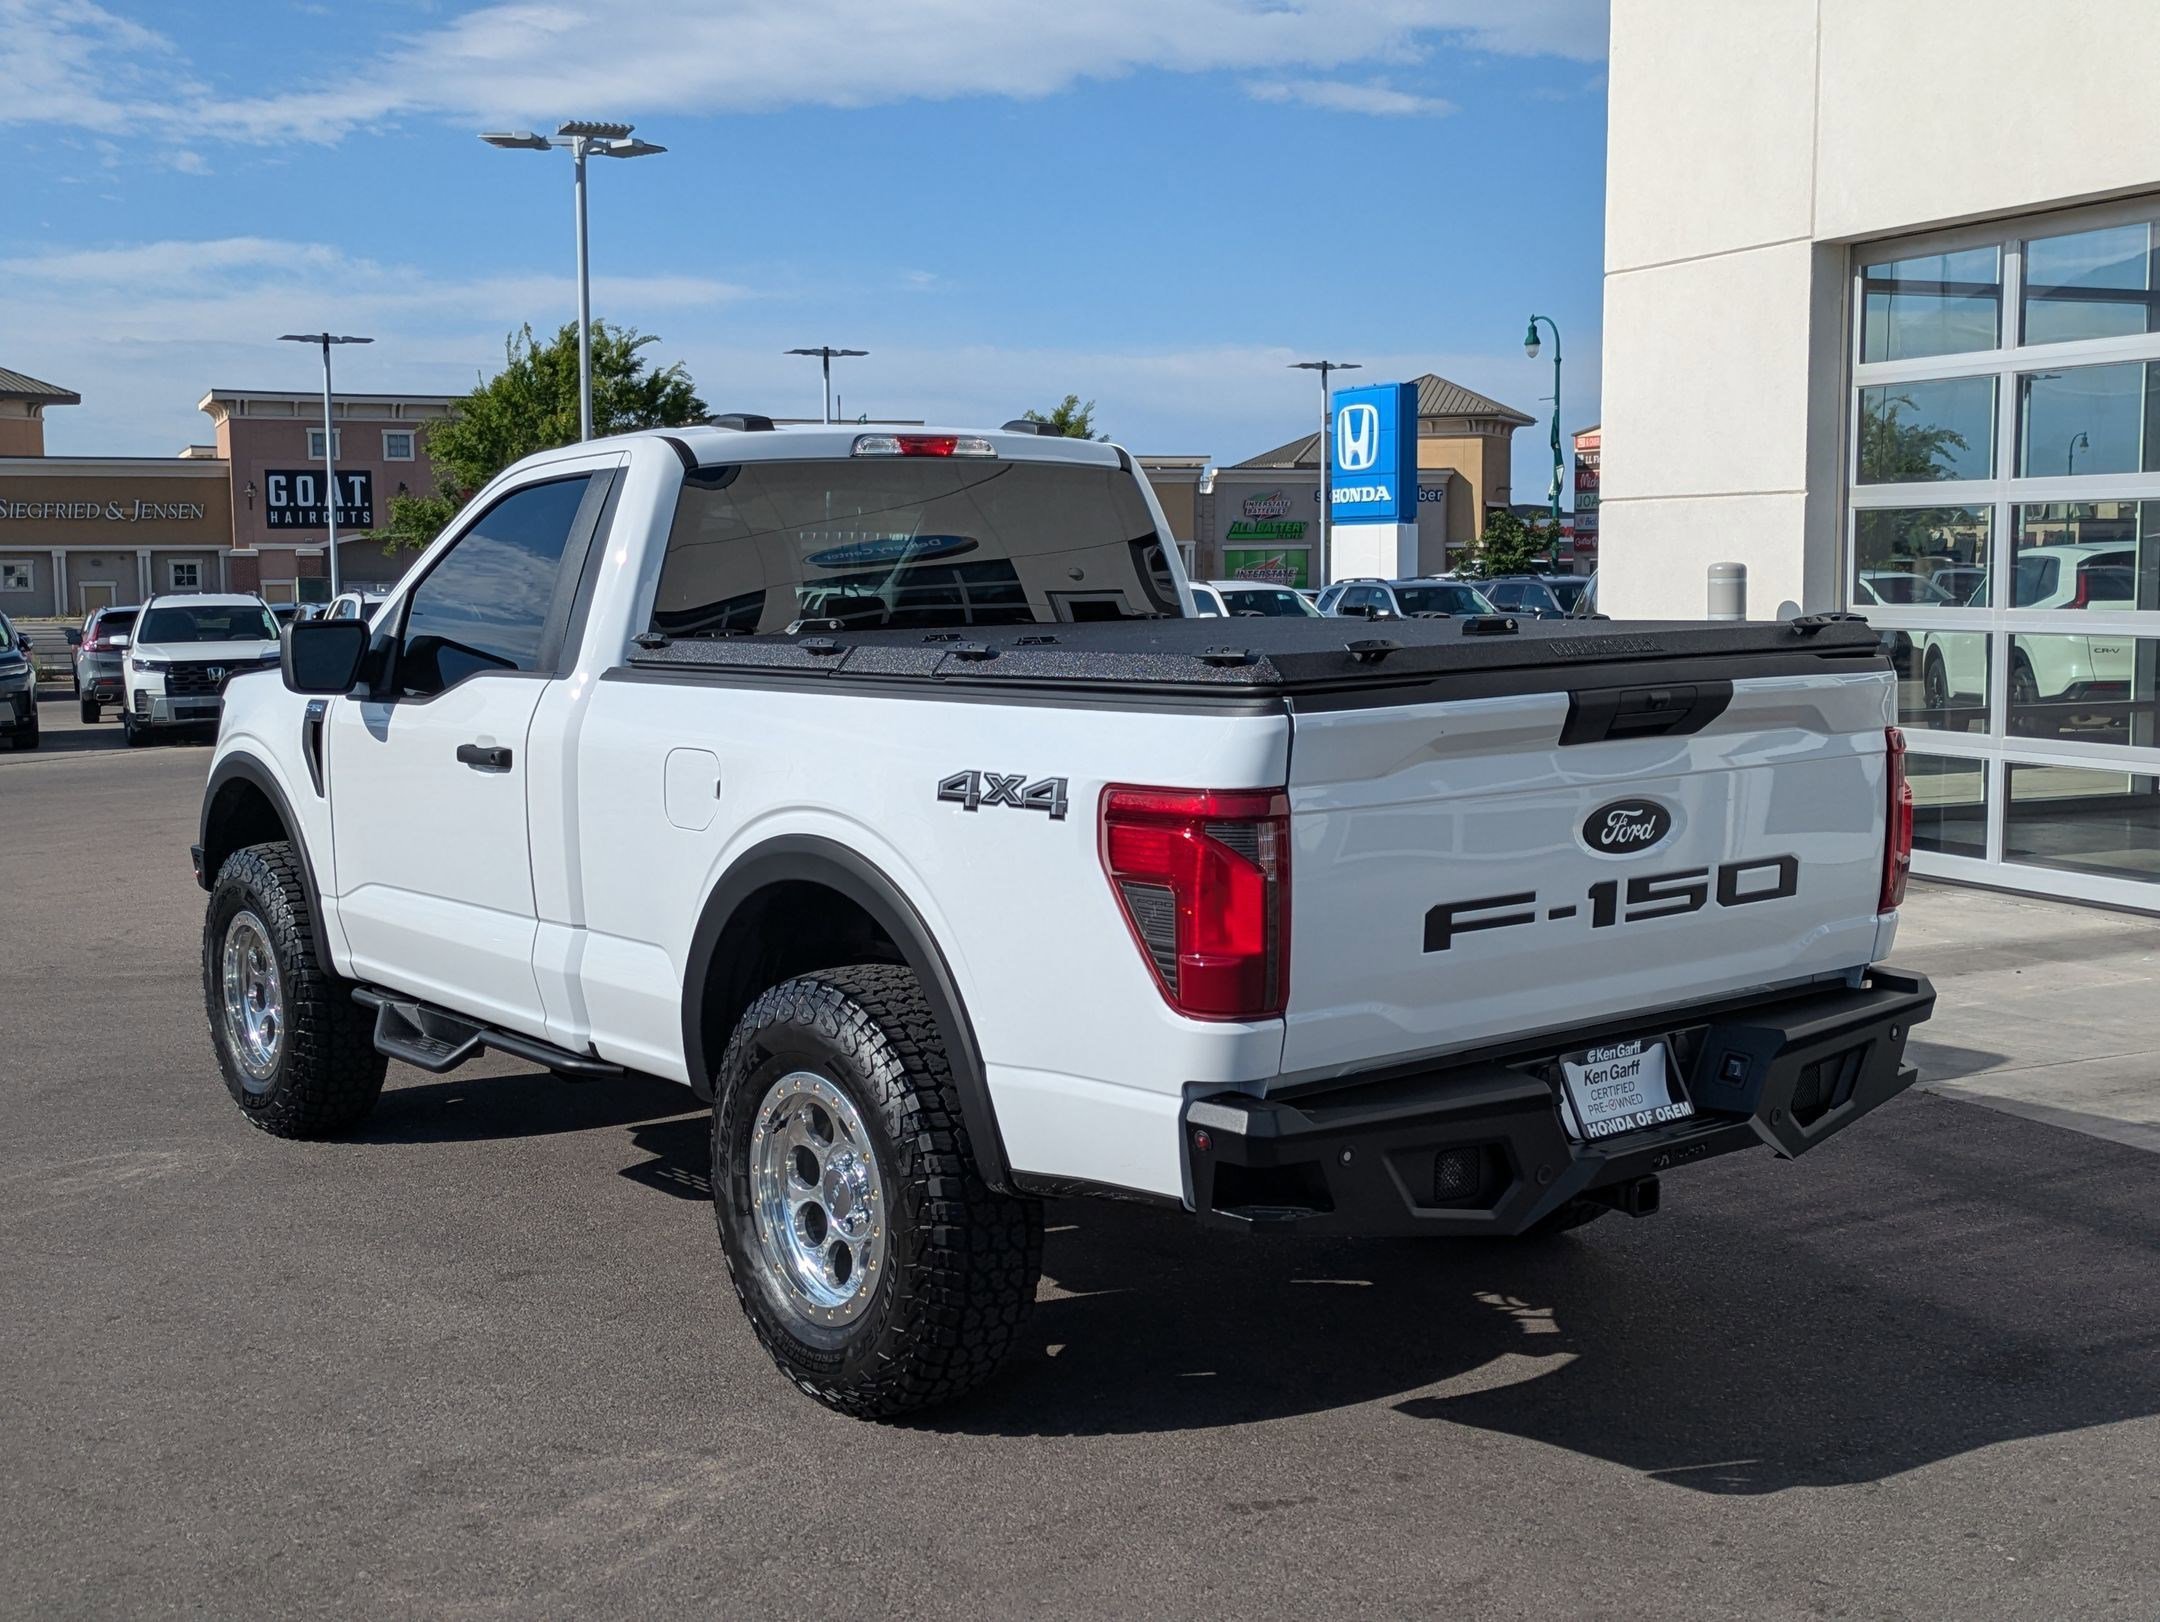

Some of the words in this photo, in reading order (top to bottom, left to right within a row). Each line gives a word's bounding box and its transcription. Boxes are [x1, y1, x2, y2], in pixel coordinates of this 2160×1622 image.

[1245, 500, 1291, 508] INTERSTATE
[1331, 486, 1392, 504] HONDA
[105, 500, 127, 521] &
[270, 511, 371, 524] HAIRCUTS
[1246, 507, 1287, 515] BATTERIES
[1231, 522, 1253, 533] ALL
[1255, 521, 1307, 533] BATTERY
[1236, 569, 1296, 578] INTERSTATE
[1601, 809, 1656, 845] Ford
[1422, 854, 1799, 954] F-150
[1596, 1046, 1616, 1061] Ken
[1617, 1040, 1642, 1057] Garff
[1584, 1068, 1609, 1087] Ken
[1609, 1059, 1641, 1080] Garff
[1590, 1081, 1635, 1101] CERTIFIED
[1587, 1093, 1644, 1115] PRE-OWNED
[1586, 1115, 1635, 1138] HONDA
[1636, 1111, 1653, 1128] OF
[1655, 1101, 1692, 1122] OREM
